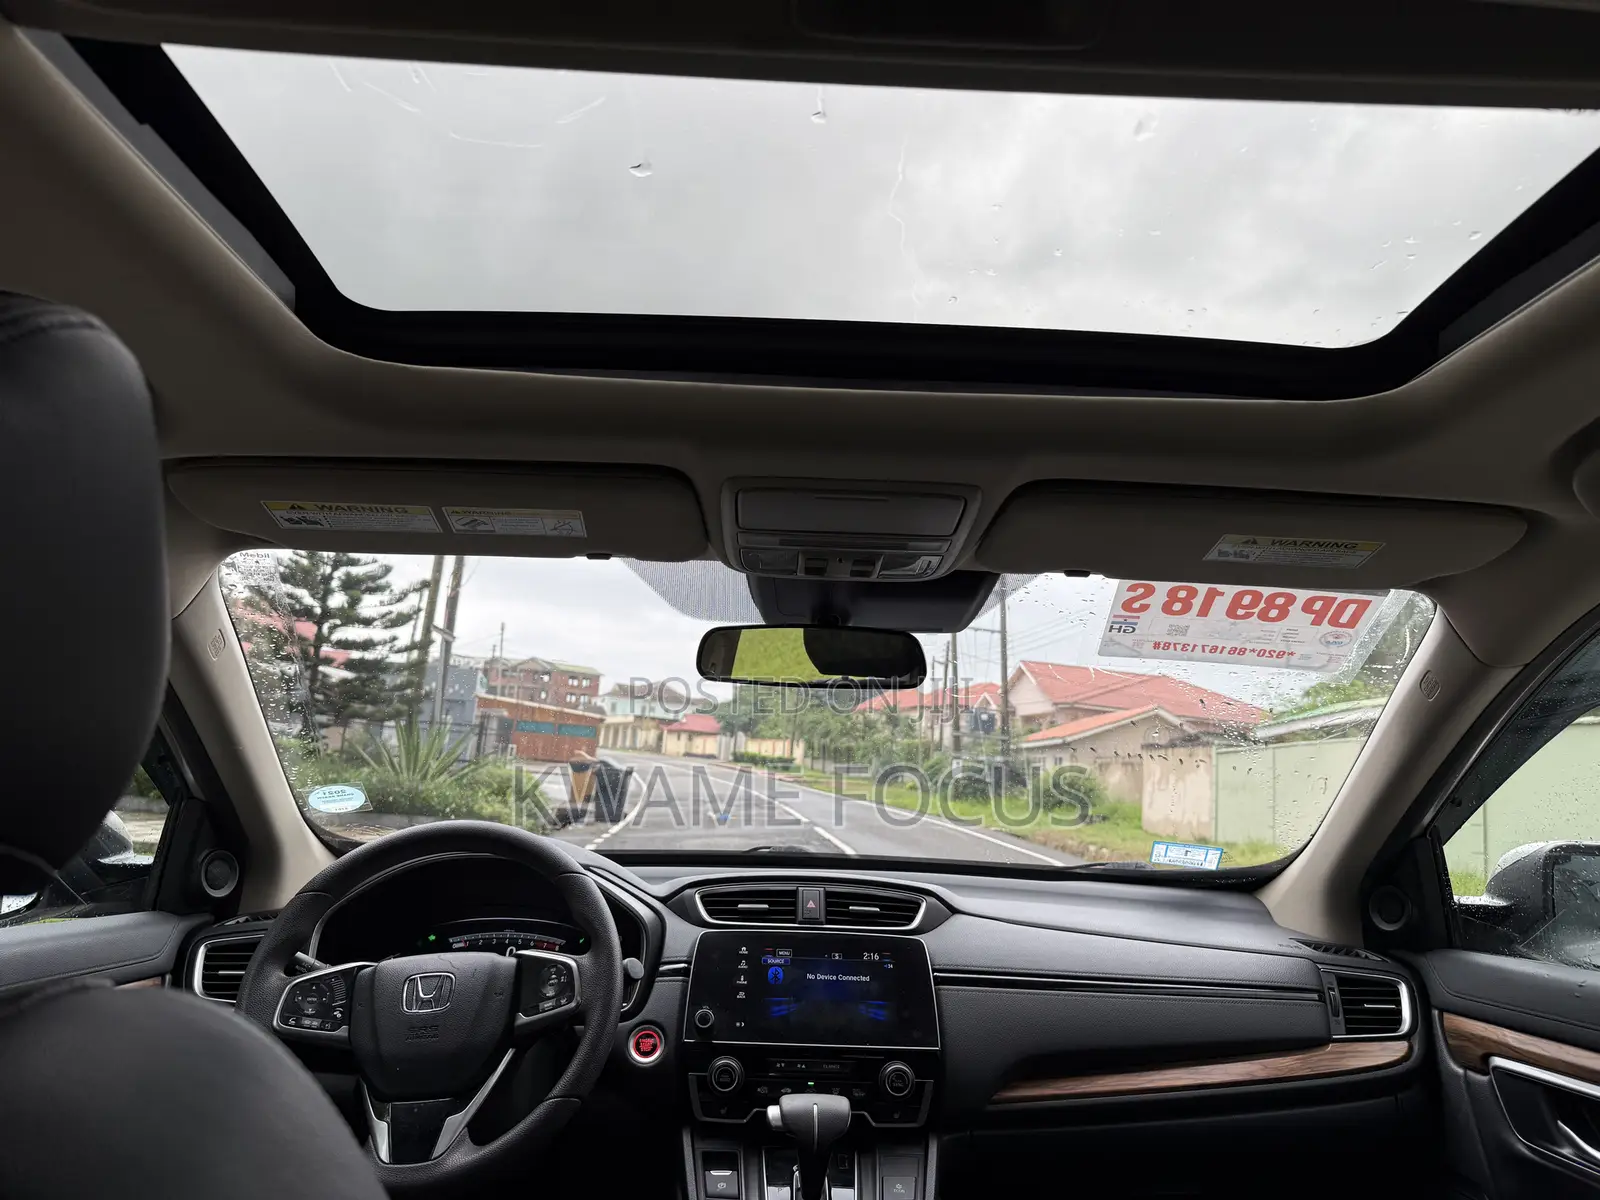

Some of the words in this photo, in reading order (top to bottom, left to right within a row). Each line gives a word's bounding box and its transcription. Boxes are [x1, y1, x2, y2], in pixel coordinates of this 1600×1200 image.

[314, 504, 408, 514] WARNING
[1271, 539, 1359, 549] WARNING
[863, 952, 880, 961] 2:16
[817, 973, 837, 981] Device
[838, 974, 870, 982] Connected
